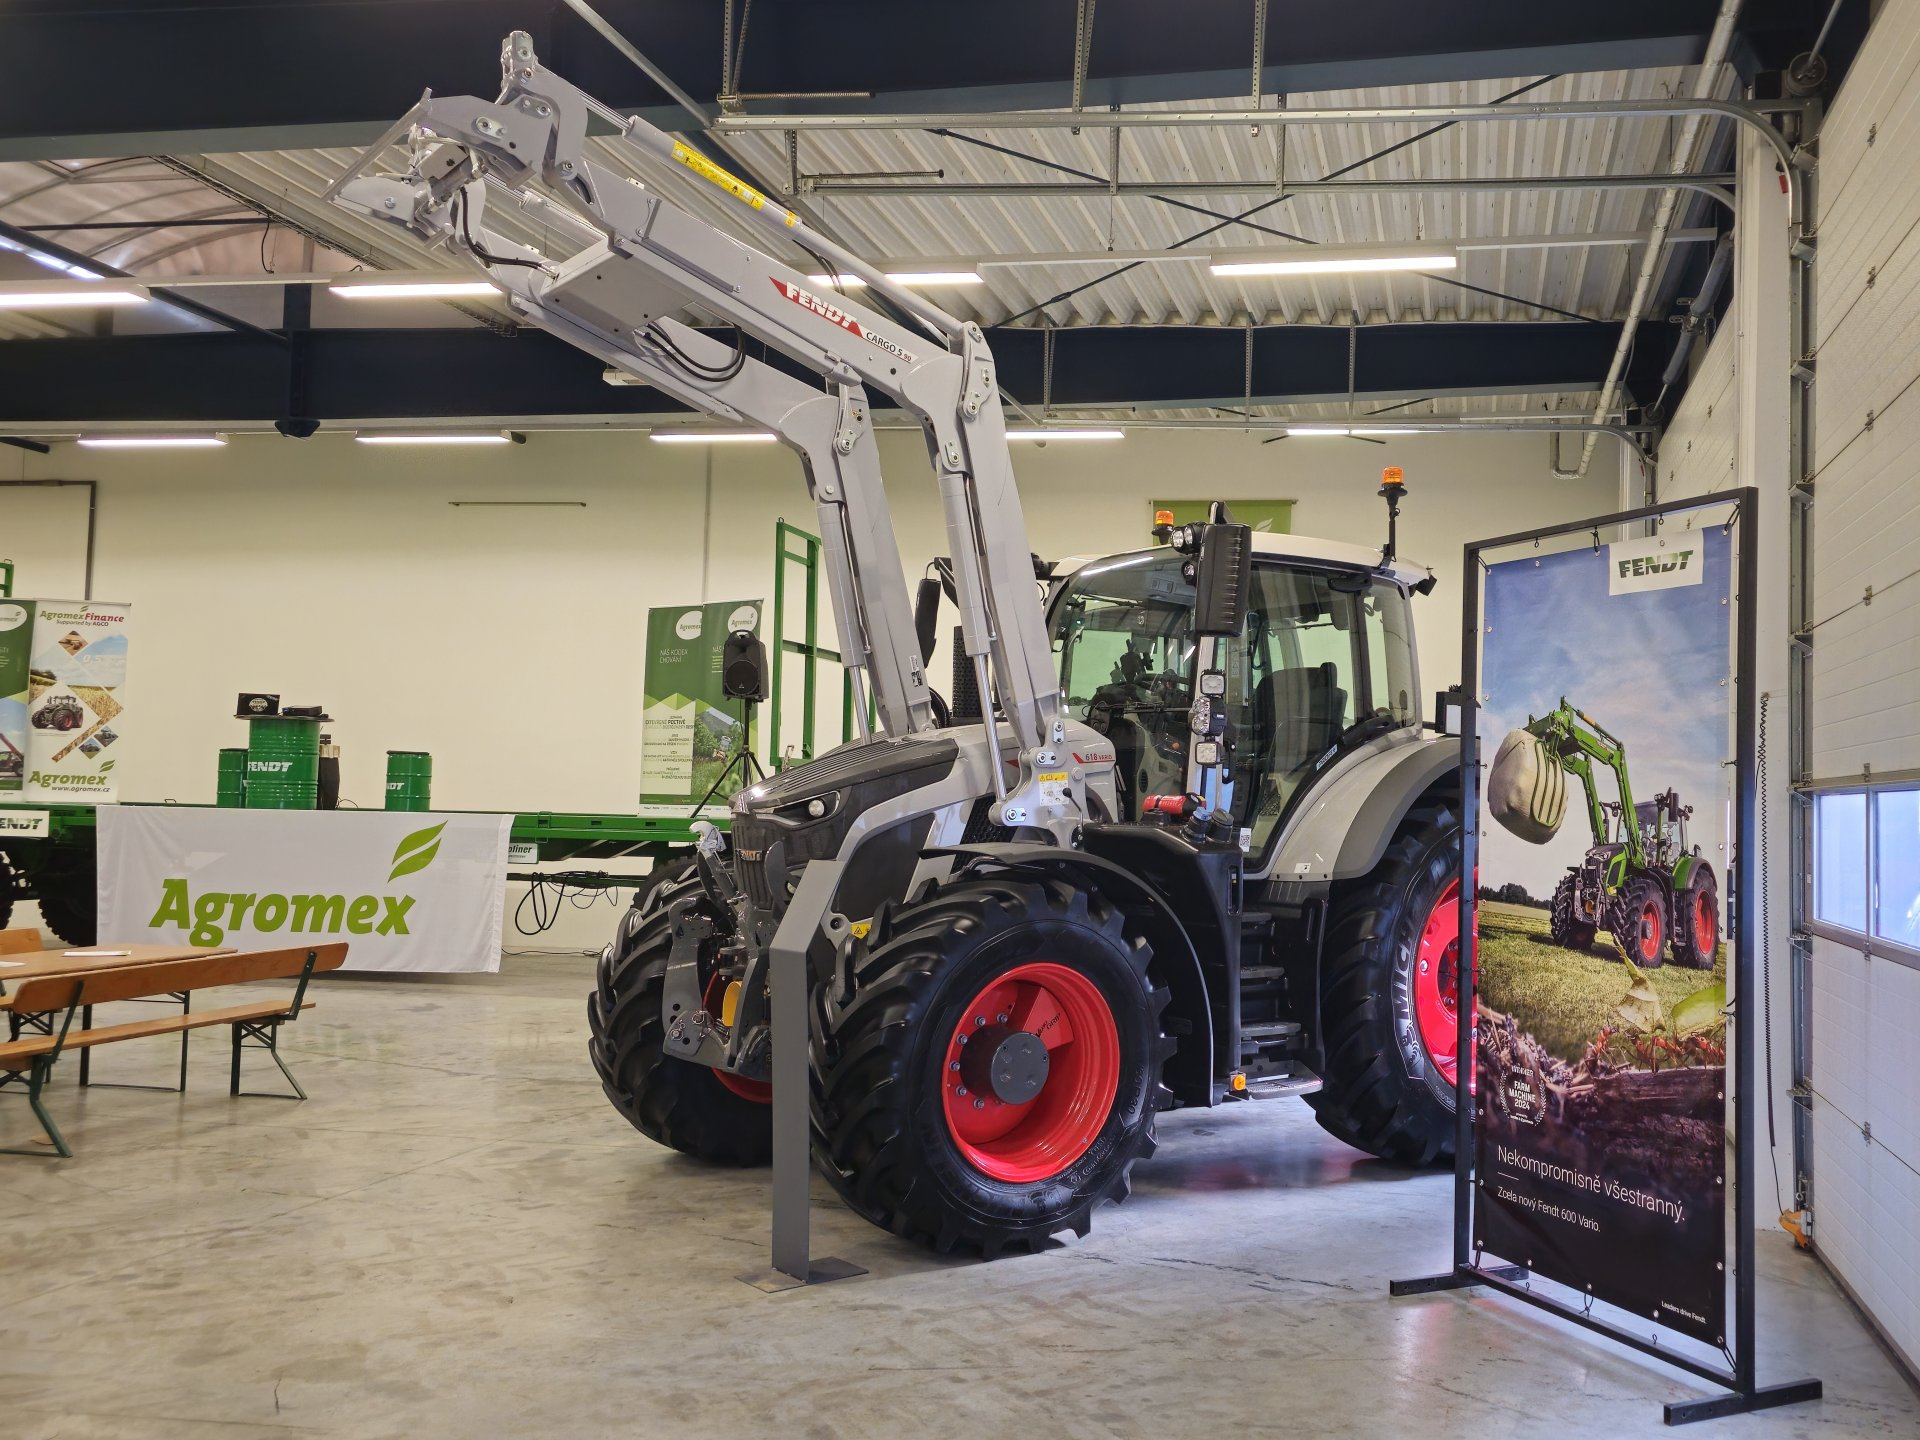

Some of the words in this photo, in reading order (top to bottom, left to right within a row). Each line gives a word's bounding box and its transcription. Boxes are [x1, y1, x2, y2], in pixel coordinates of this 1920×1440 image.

[786, 281, 856, 329] FENDT
[866, 331, 897, 353] CARGO
[1618, 549, 1694, 579] FENDT
[248, 761, 293, 772] FENDT
[29, 770, 107, 787] Agromex
[0, 818, 43, 829] ENDT
[508, 844, 533, 853] oliner
[148, 878, 416, 947] Agromex
[1514, 1080, 1531, 1092] FARM
[1509, 1087, 1536, 1103] MACHINE
[1514, 1098, 1530, 1110] 2024
[1498, 1144, 1601, 1193] Nekompromisně
[1604, 1180, 1685, 1224] všestranný.
[1497, 1186, 1517, 1203] Zcela
[1518, 1193, 1536, 1211] nový
[1537, 1200, 1559, 1218] Fendt
[1561, 1208, 1577, 1224] 600
[1578, 1211, 1601, 1233] Vario.
[1661, 1300, 1680, 1314] Leaders
[1680, 1308, 1691, 1318] drive
